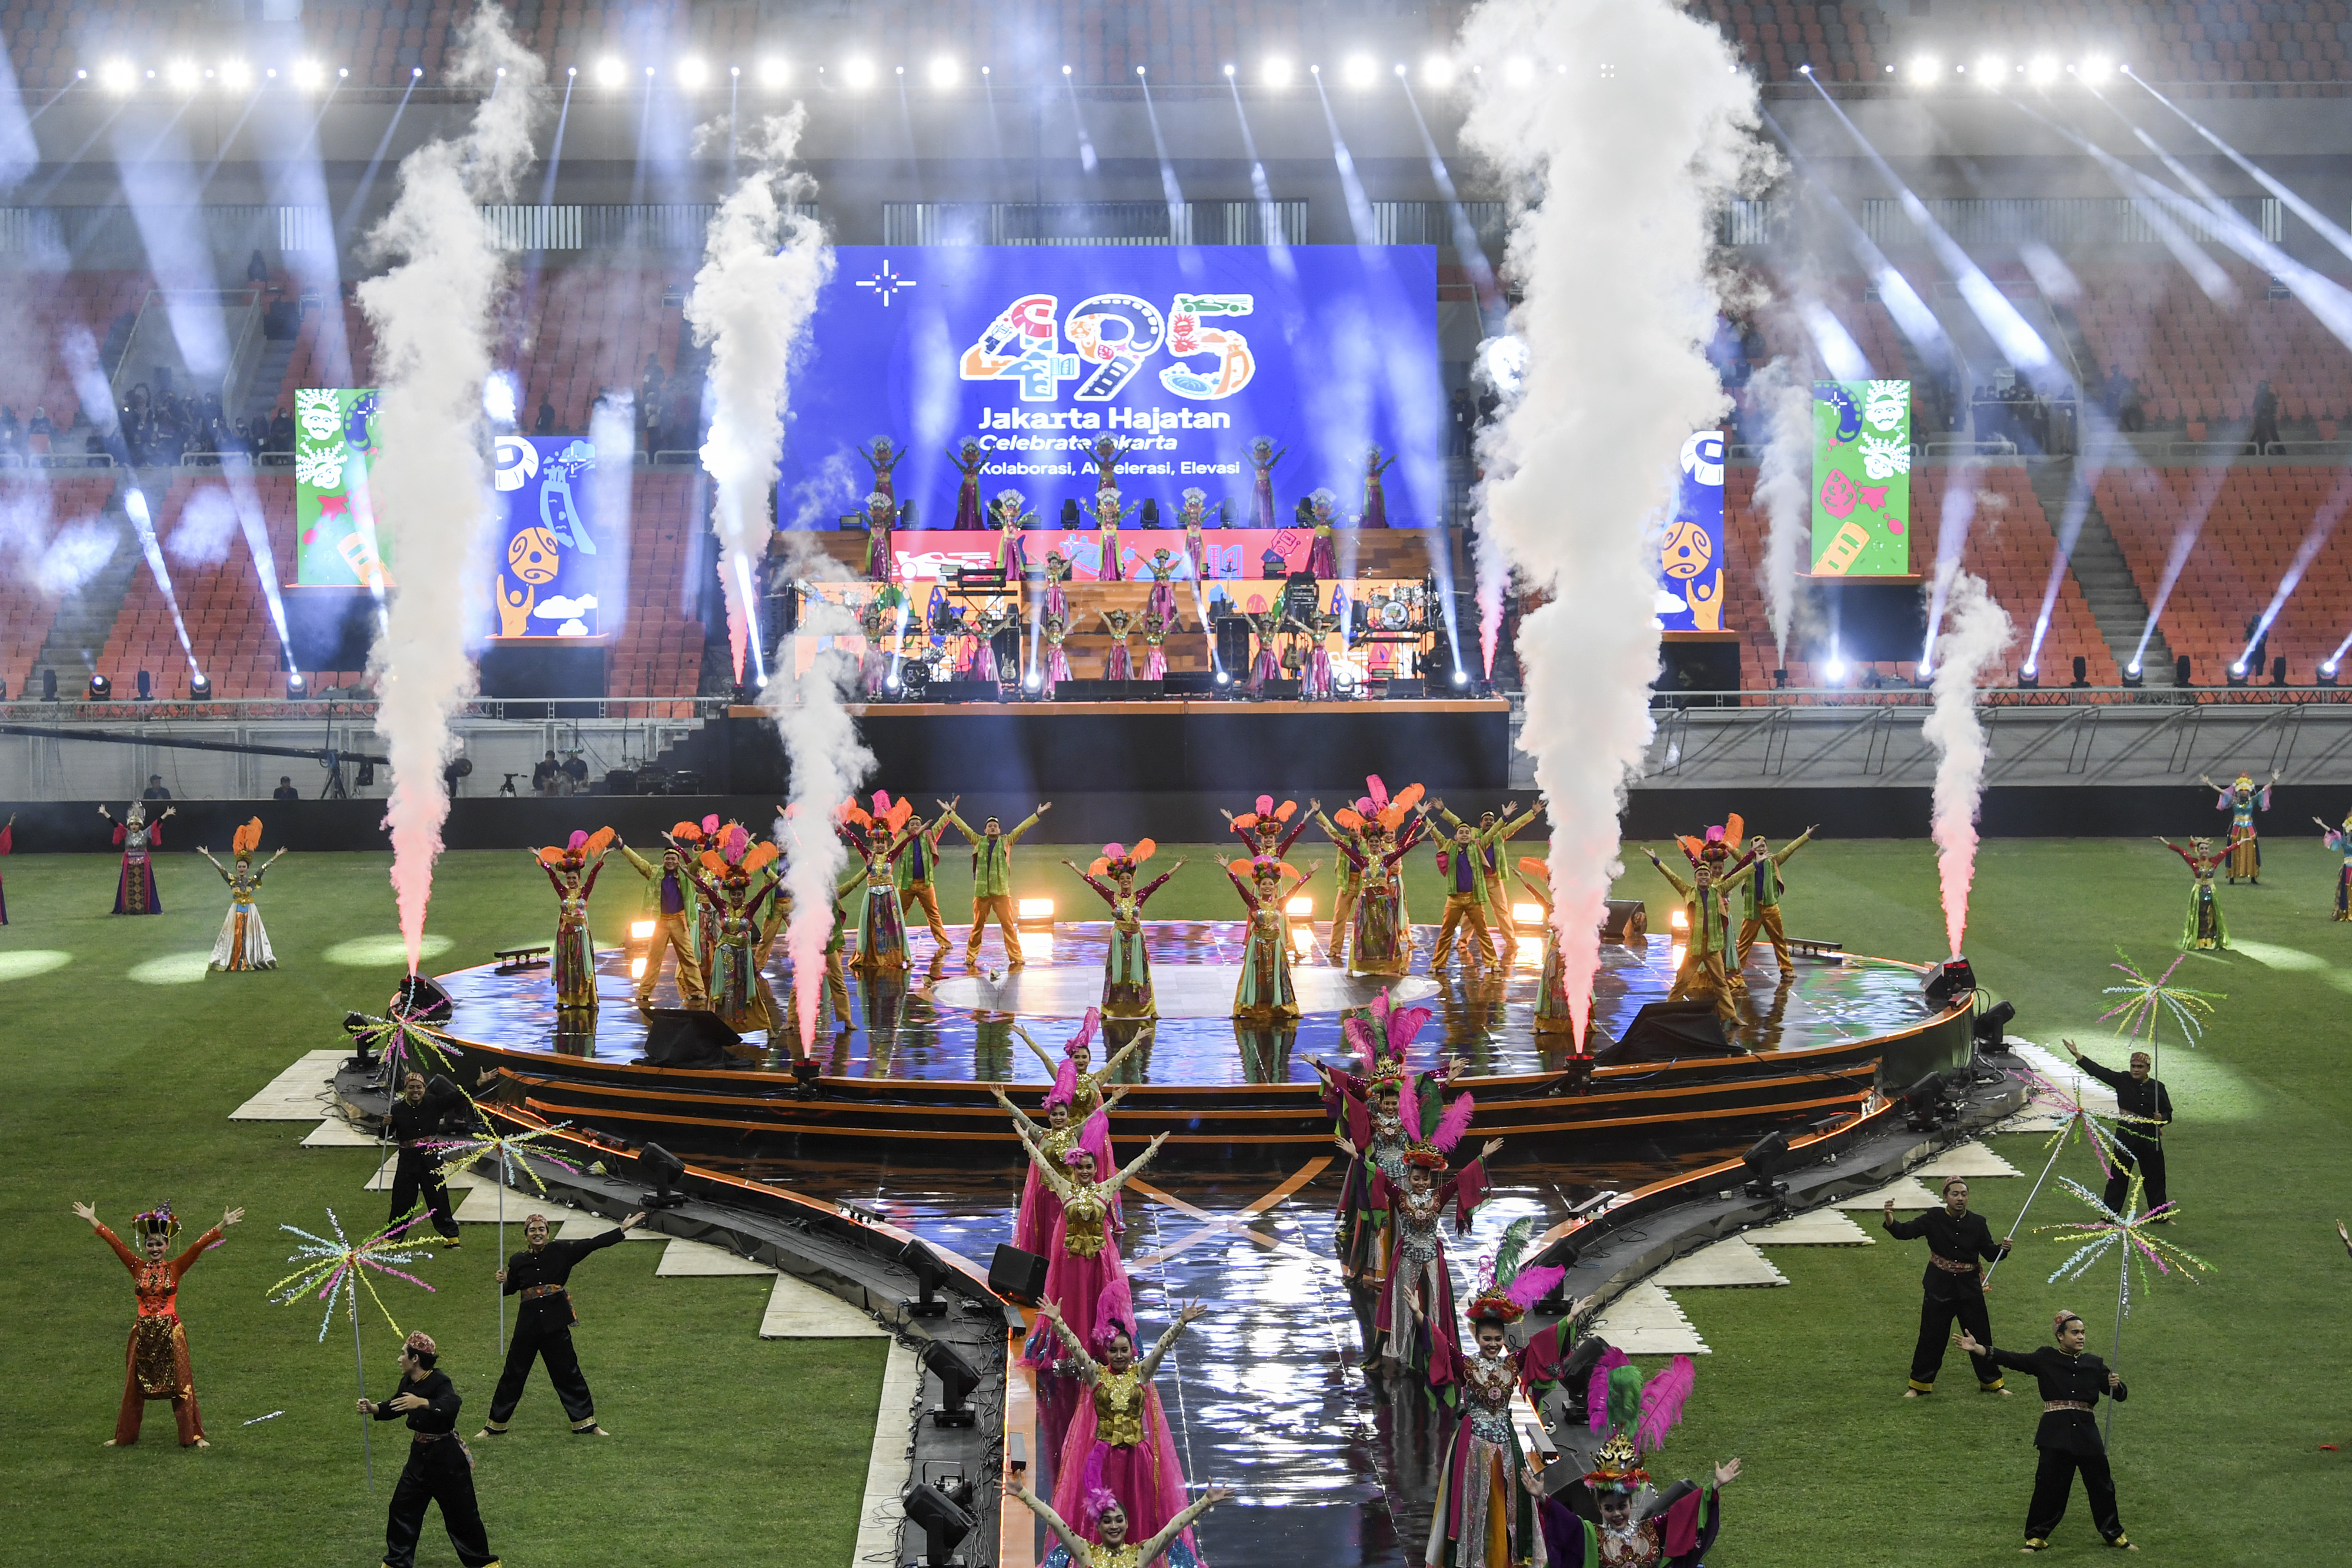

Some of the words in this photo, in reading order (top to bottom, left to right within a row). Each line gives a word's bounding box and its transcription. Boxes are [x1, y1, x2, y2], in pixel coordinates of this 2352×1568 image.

[960, 293, 1255, 402] 495
[978, 407, 1100, 429] Jakarta
[1108, 407, 1230, 434] Hajatan
[978, 434, 1092, 450] Celebrate
[1094, 434, 1178, 450] karta
[978, 462, 1076, 476] Kolaborasi,
[1081, 462, 1175, 476] Aelerasi,
[1181, 462, 1240, 474] Elevasi
